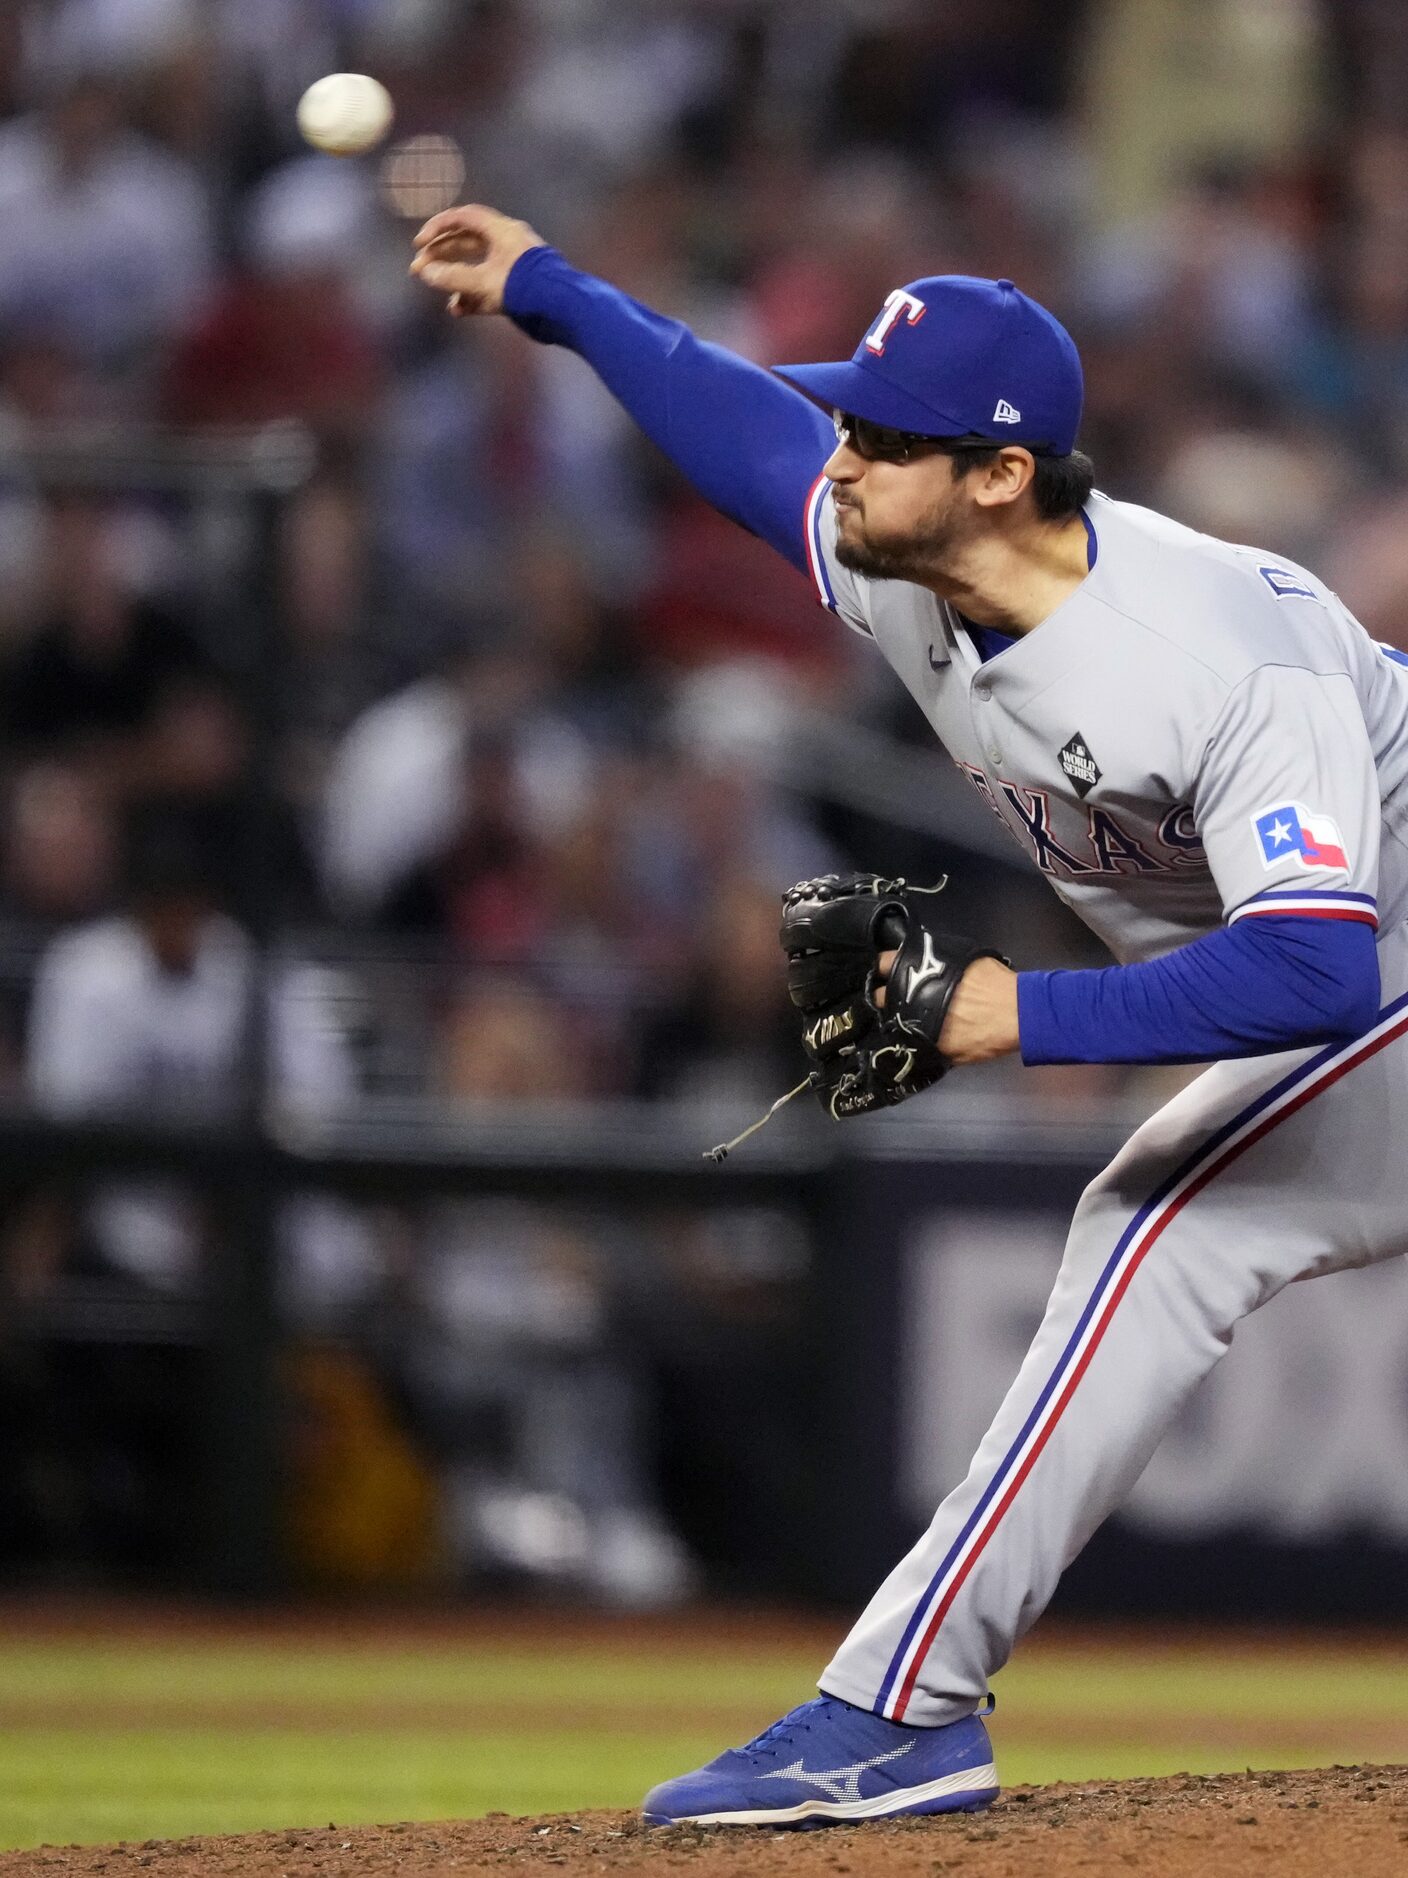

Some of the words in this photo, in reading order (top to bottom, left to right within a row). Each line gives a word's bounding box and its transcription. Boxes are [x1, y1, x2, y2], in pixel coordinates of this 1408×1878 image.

[865, 288, 927, 357] T
[1062, 749, 1096, 773] WORLD
[1062, 760, 1097, 785] SERIES
